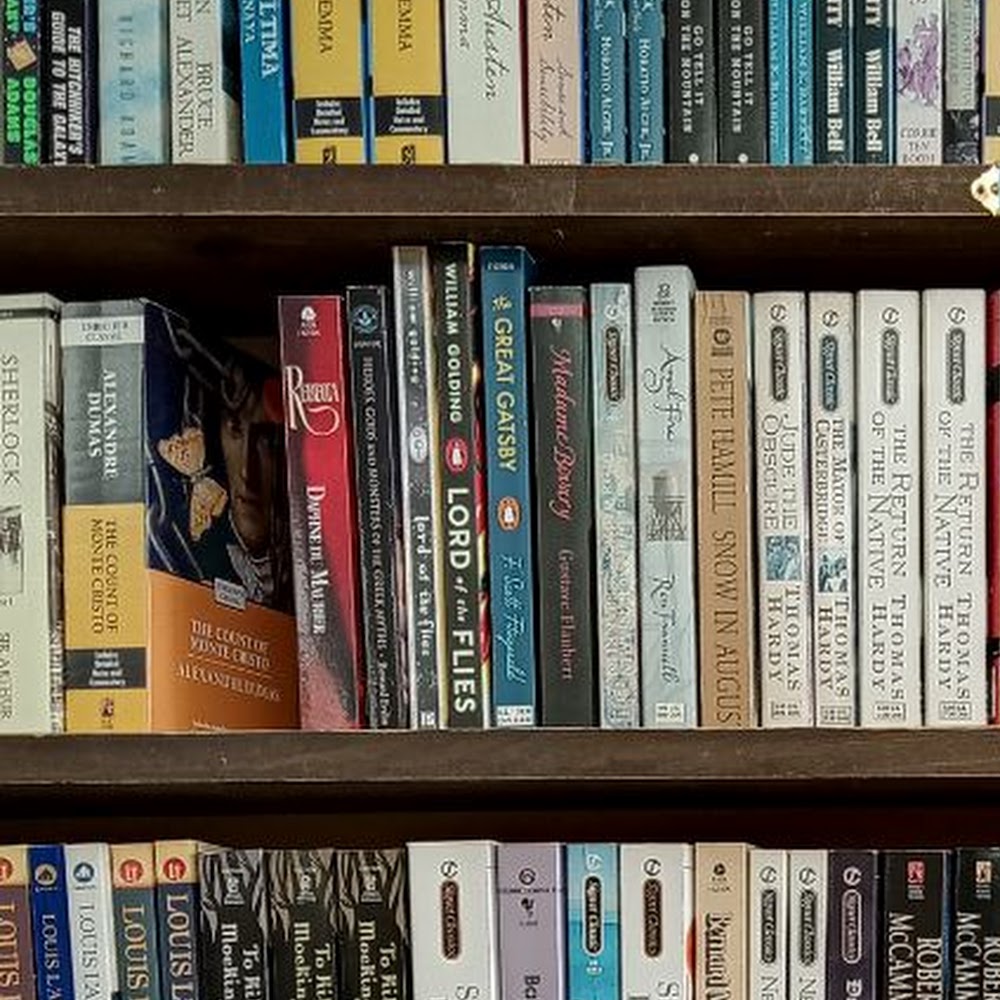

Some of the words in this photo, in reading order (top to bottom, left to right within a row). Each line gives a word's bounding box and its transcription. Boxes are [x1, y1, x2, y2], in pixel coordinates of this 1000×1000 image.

[681, 26, 692, 52] THE
[693, 52, 705, 87] TELL
[694, 26, 705, 47] GO
[7, 78, 21, 143] ADAMS
[175, 36, 195, 158] ALEXANDER
[195, 61, 213, 129] BRUCE
[682, 60, 693, 133] MOUNTAIN
[695, 91, 705, 107] IT
[826, 48, 843, 113] William
[23, 77, 39, 164] DOUGLAS
[827, 116, 844, 153] Bell
[444, 264, 459, 335] WILLIAM
[446, 344, 464, 423] GOLDING
[494, 318, 515, 384] GREAT
[1, 354, 20, 487] SHERLOCK
[88, 391, 102, 459] DUMAS
[101, 369, 120, 481] ALEXANDRE
[549, 347, 574, 440] Madame
[871, 411, 886, 440] OF
[496, 391, 517, 472] GATSBY
[872, 447, 886, 485] THE
[892, 426, 906, 464] THE
[447, 488, 471, 571] LORD
[868, 492, 890, 591] NATIVE
[889, 472, 911, 578] RETURN
[453, 577, 467, 594] of
[454, 599, 468, 623] the
[451, 629, 476, 714] FLIES
[871, 603, 888, 691] HARDY
[890, 593, 907, 701] THOMAS
[166, 892, 190, 978] LOUIS
[241, 947, 258, 968] To
